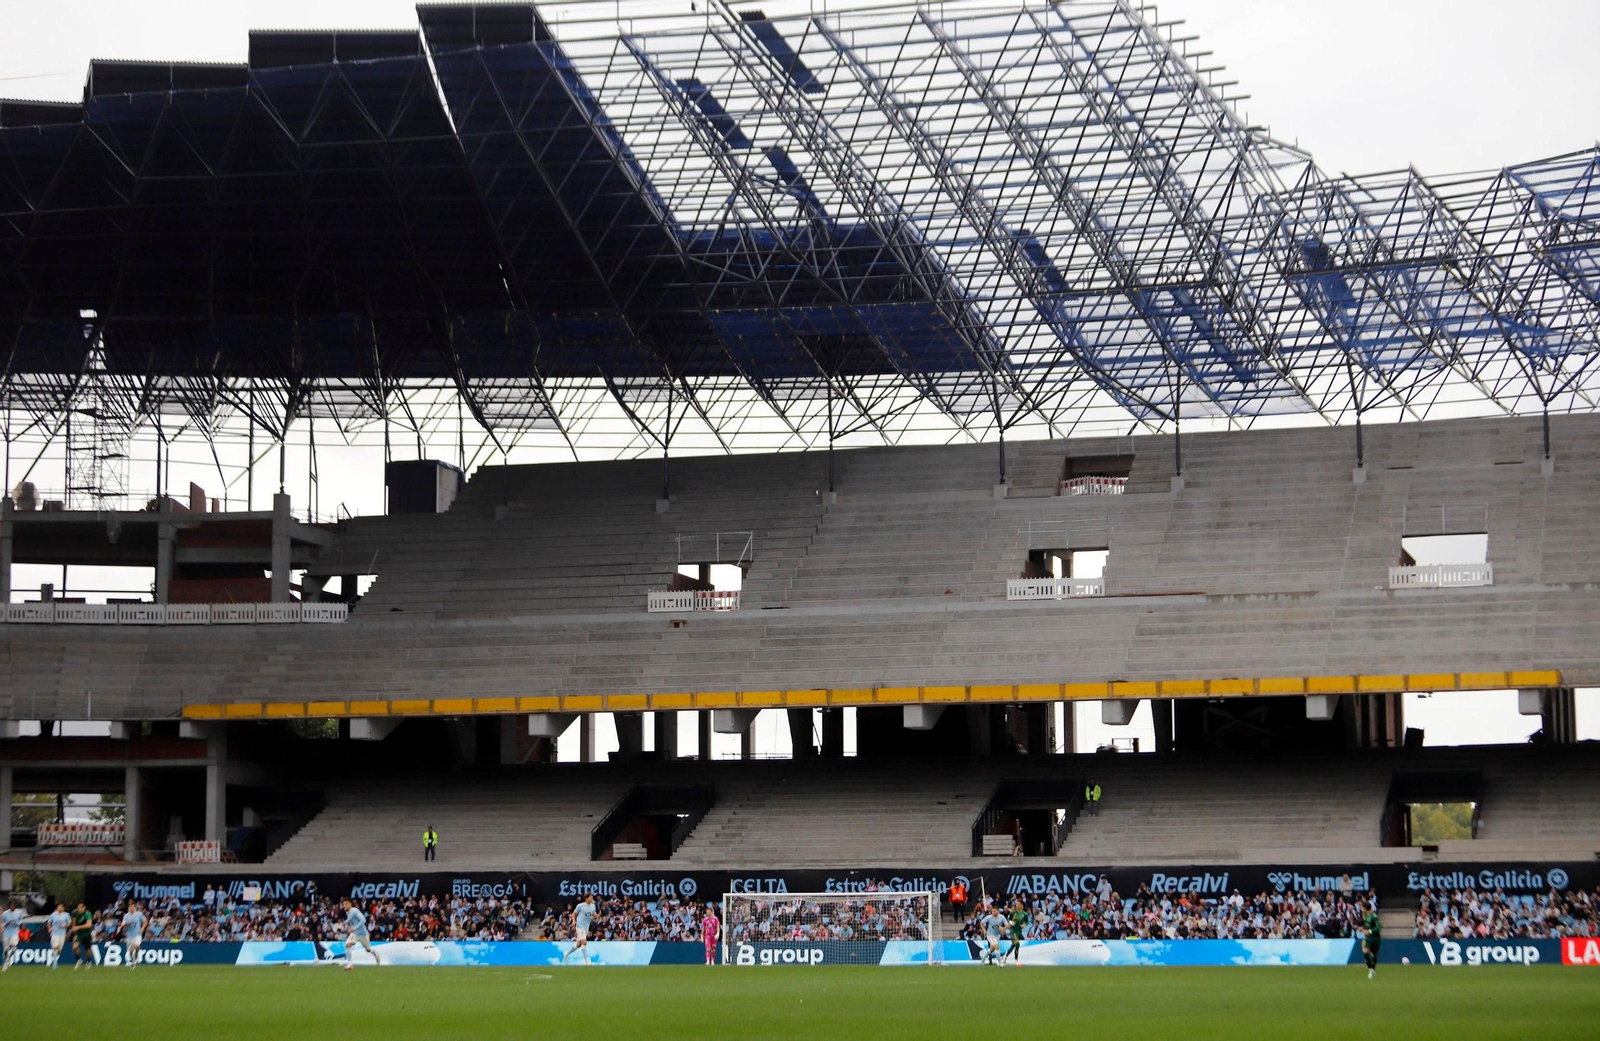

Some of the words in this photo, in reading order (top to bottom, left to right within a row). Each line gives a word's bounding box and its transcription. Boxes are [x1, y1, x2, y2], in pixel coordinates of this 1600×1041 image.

[559, 880, 617, 896] Estrella
[621, 879, 675, 896] Galicia
[732, 879, 788, 894] CELTA
[890, 877, 949, 894] Galicia
[1151, 873, 1229, 893] Recalvi
[1407, 872, 1475, 889] Estrella
[1479, 870, 1543, 888] Galicia
[134, 882, 195, 899] hummel
[351, 880, 420, 898] Recalvi
[453, 880, 526, 898] BREOGÁ
[760, 949, 824, 966] group
[1466, 945, 1540, 966] group
[1568, 940, 1600, 964] LA
